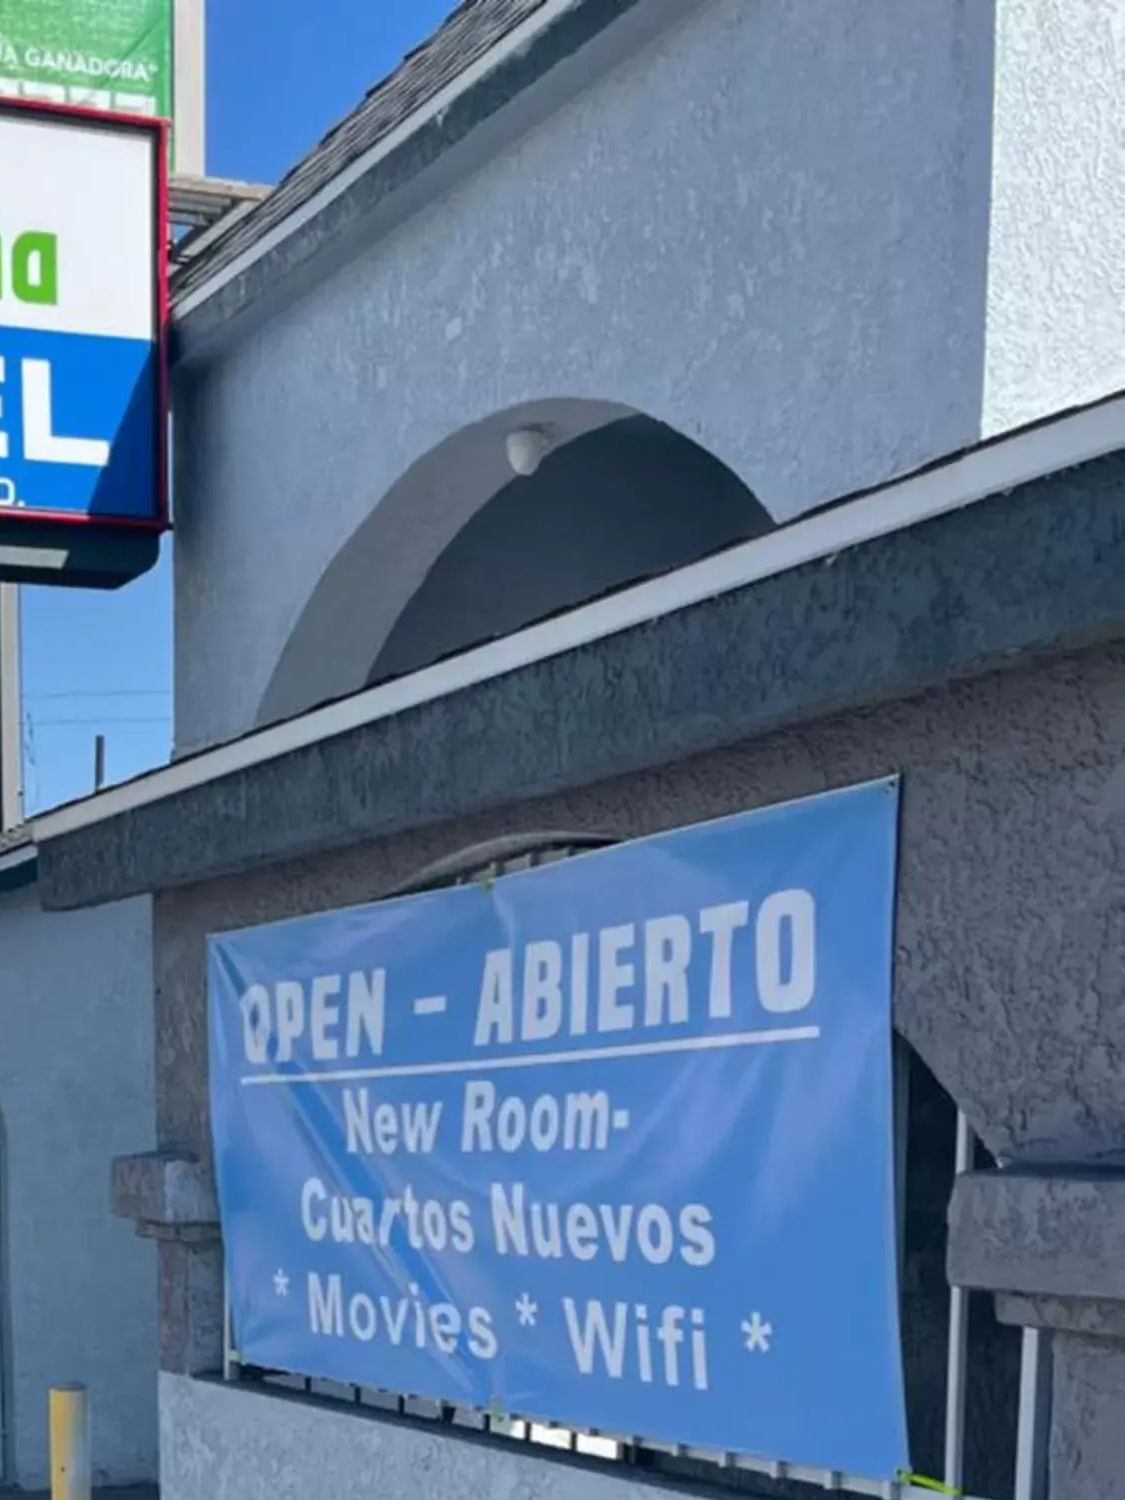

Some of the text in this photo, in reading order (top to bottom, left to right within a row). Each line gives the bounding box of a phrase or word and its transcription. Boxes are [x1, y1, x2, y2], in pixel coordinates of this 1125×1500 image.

[240, 967, 386, 1064] OPEN
[474, 888, 817, 1046] ABIERTO
[343, 1087, 442, 1154] New
[301, 1176, 715, 1266] Cuartos Nuevos
[307, 1271, 708, 1391] Movies Wifi
